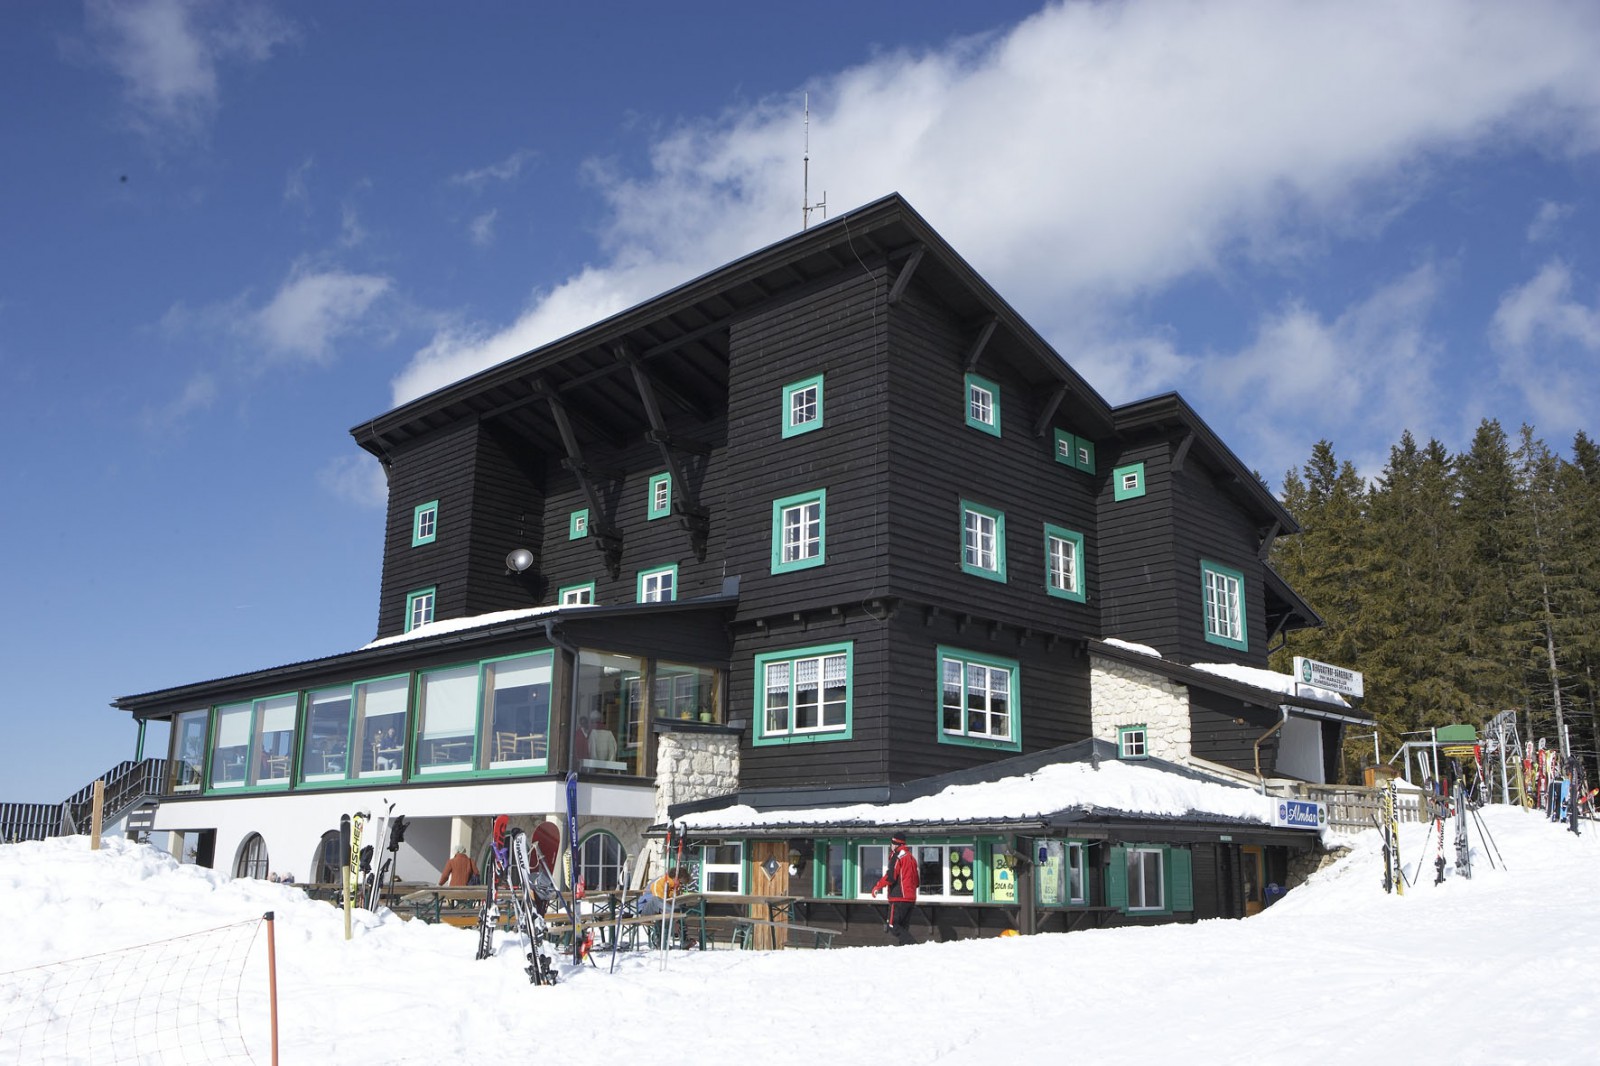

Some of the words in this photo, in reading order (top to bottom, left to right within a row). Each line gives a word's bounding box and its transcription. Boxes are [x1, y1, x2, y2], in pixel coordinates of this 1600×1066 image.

[1288, 804, 1317, 823] Almbar
[350, 820, 361, 875] FISCHER
[515, 836, 526, 870] ATOMIC
